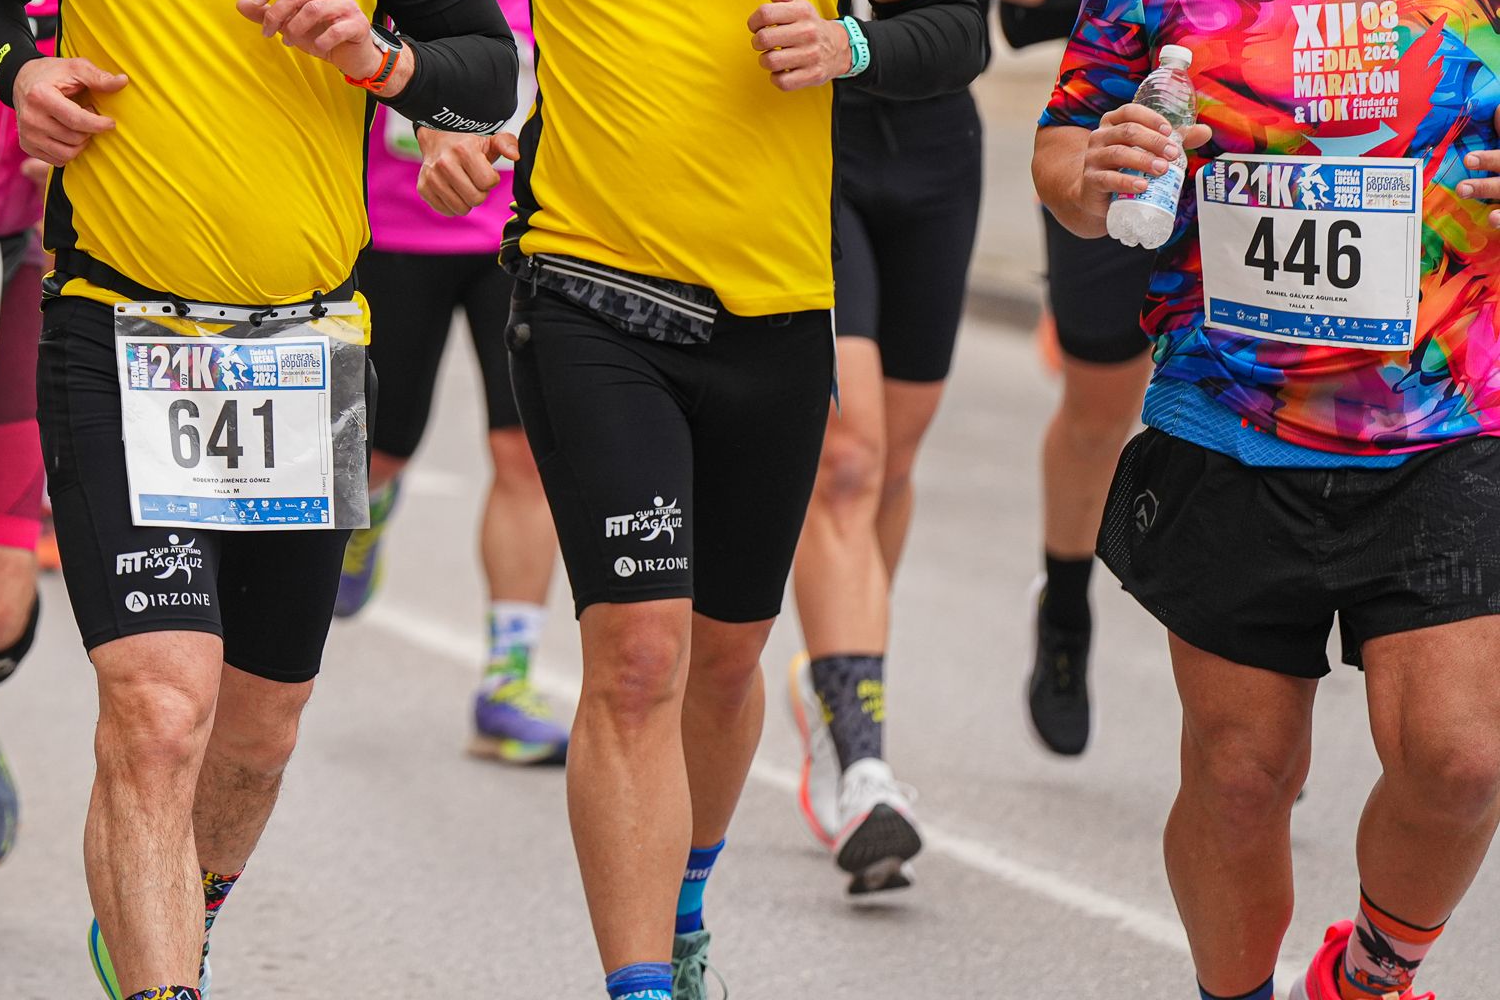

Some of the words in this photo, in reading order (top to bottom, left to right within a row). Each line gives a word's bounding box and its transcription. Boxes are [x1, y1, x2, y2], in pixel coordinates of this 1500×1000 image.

[1291, 2, 1359, 49] XII
[1361, 1, 1399, 30] 08
[1363, 31, 1399, 44] MARZO
[1293, 47, 1363, 73] MEDIA
[1364, 45, 1400, 61] 2026
[1293, 66, 1399, 98] MARATÓN
[1294, 107, 1305, 124] &
[1307, 98, 1349, 123] 10K
[1352, 96, 1385, 108] Ciudad
[1386, 96, 1399, 106] de
[1352, 106, 1398, 120] LUCENA
[1206, 175, 1216, 200] MEDIA
[1213, 161, 1225, 202] MARATÓN
[1228, 162, 1294, 208] 21K
[1334, 176, 1360, 185] LUCENA
[1366, 176, 1404, 184] carreras
[1366, 181, 1411, 192] populares
[1334, 193, 1361, 208] 2026
[1244, 216, 1362, 289] 446
[1266, 289, 1288, 298] DANIEL
[1289, 292, 1315, 300] GÁLVEZ
[137, 345, 149, 388] MARATÓN
[150, 345, 215, 389] 21K
[251, 355, 276, 364] LUCENA
[281, 358, 321, 369] populares
[130, 361, 140, 388] MEDIA
[253, 372, 277, 387] 2026
[168, 399, 276, 469] 641
[636, 509, 654, 517] CLUB
[149, 547, 169, 555] CLUB
[170, 547, 202, 556] ATLETISMO
[614, 556, 689, 577] AIRZONE
[125, 591, 211, 612] AIRZONE
